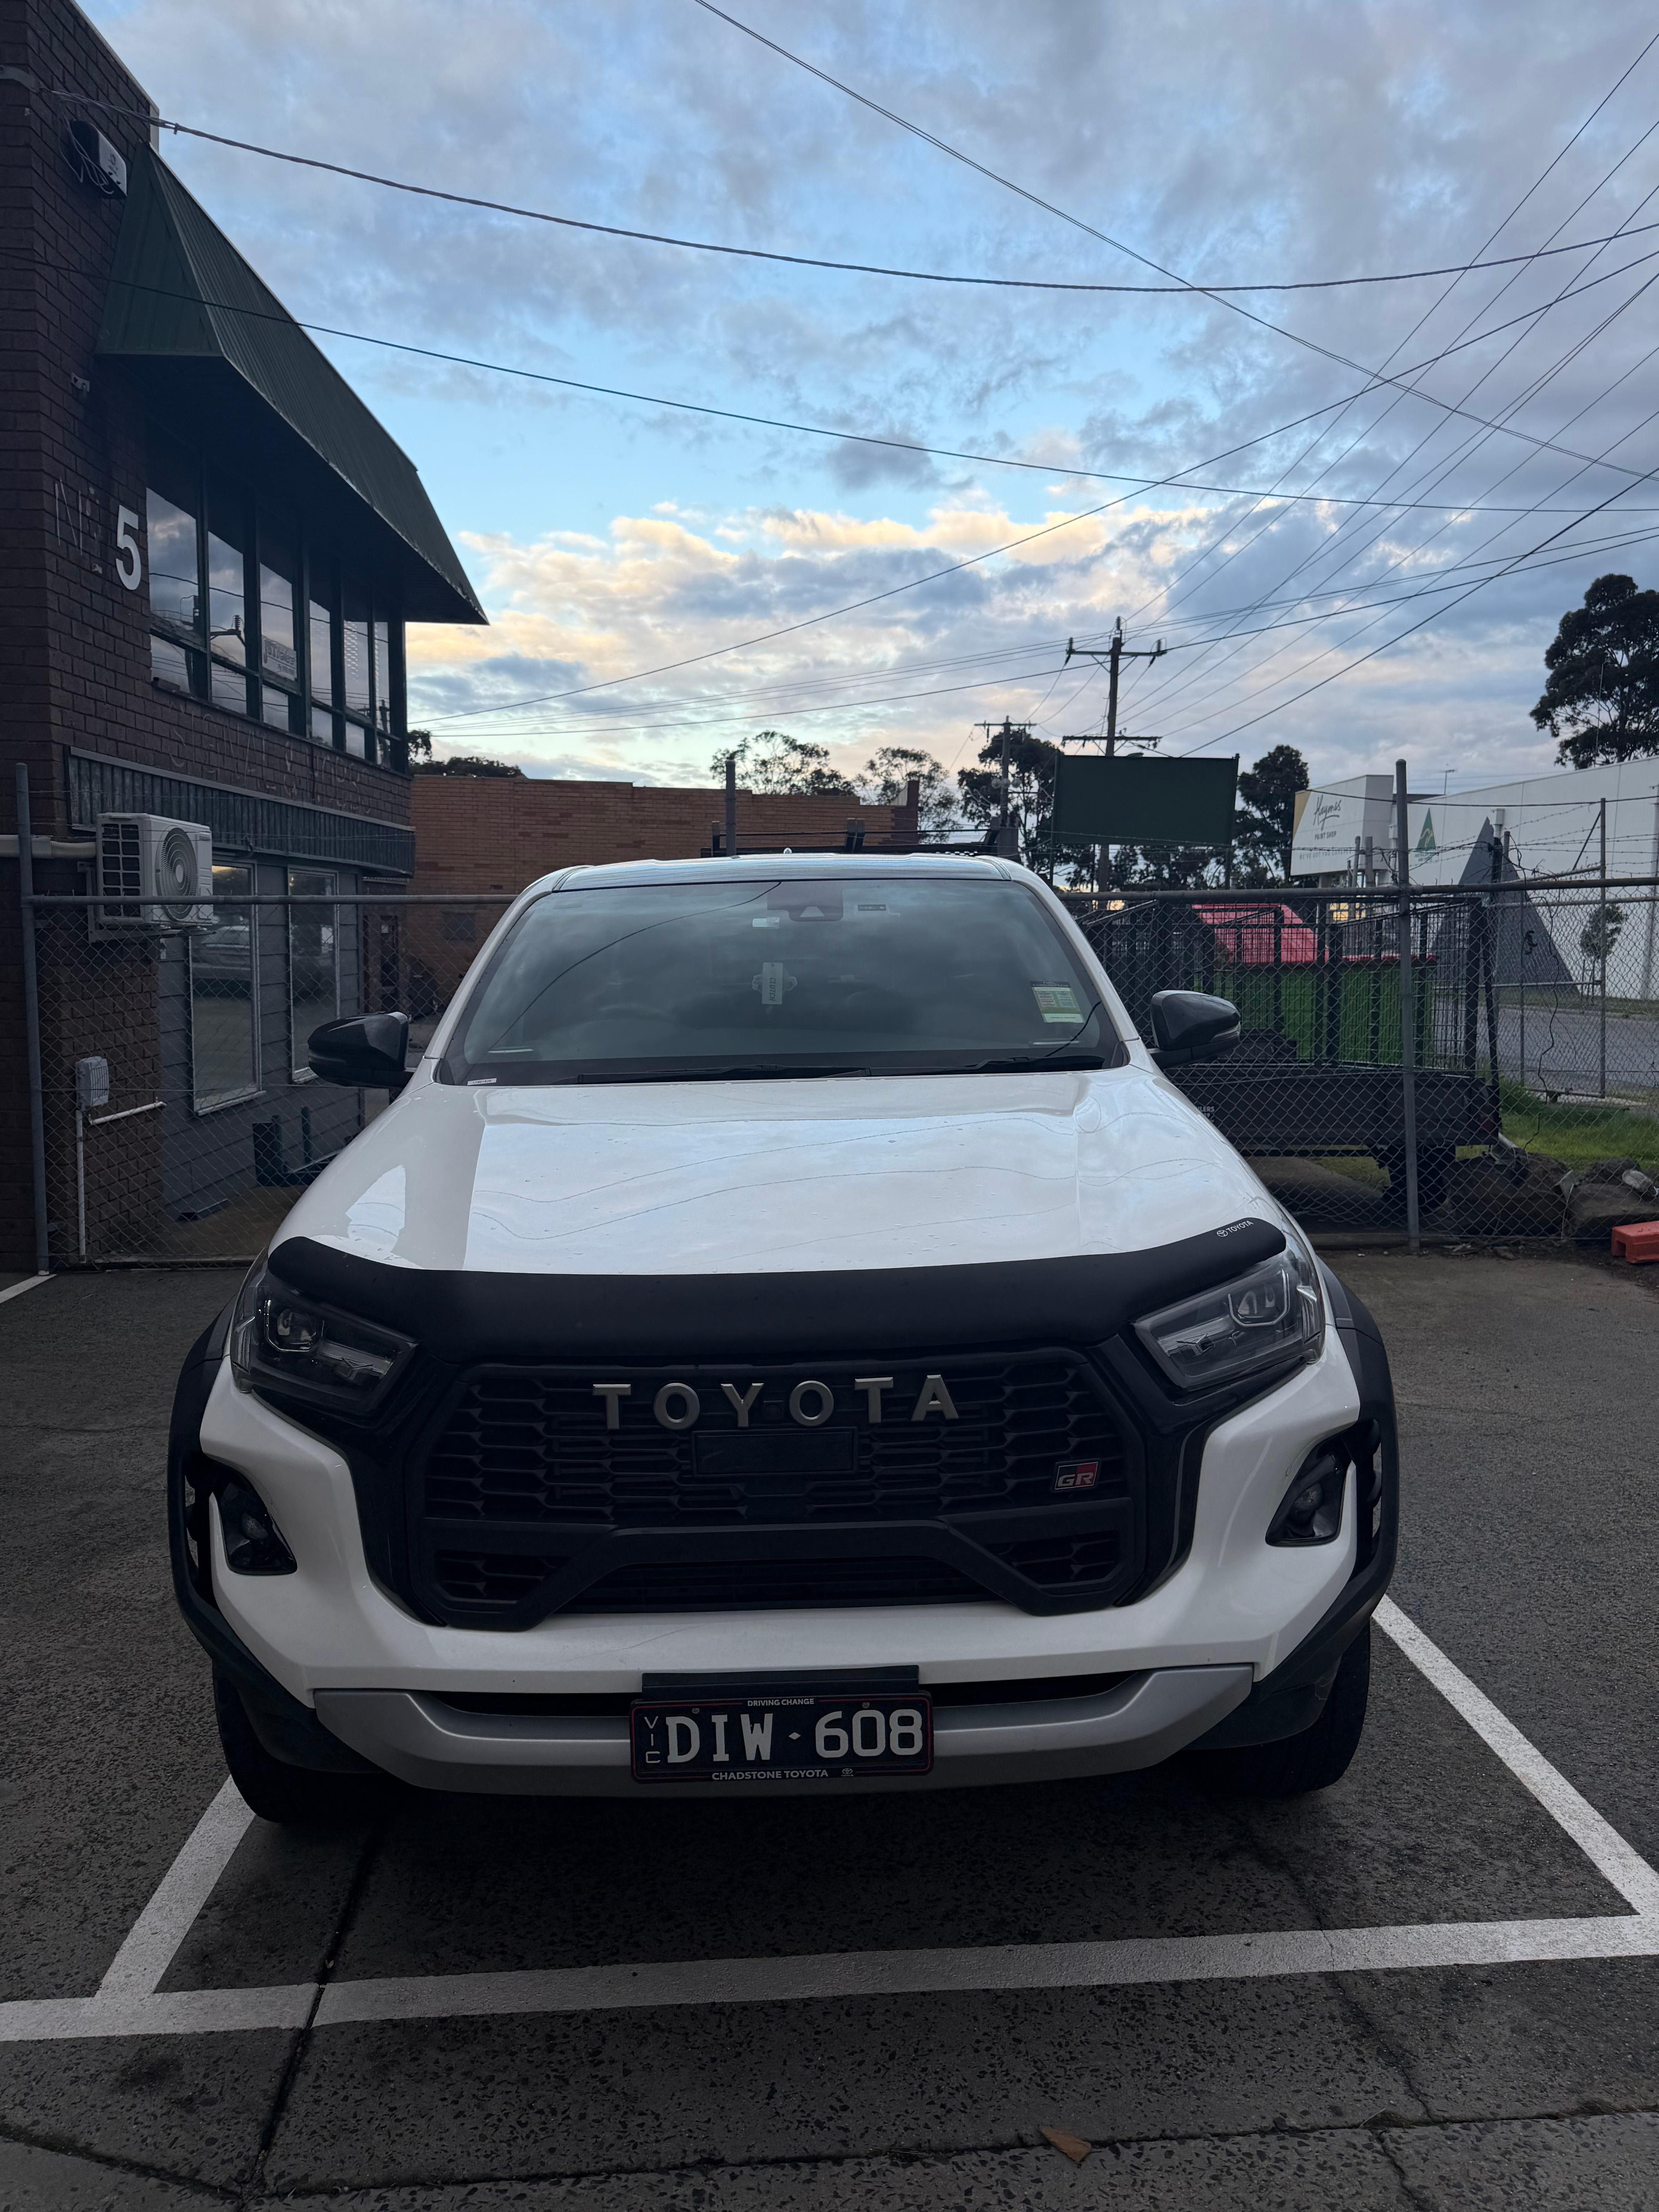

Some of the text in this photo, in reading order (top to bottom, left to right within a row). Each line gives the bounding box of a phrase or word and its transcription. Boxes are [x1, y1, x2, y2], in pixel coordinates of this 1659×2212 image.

[115, 505, 141, 591] 5
[1313, 794, 1342, 831] Haymes
[1314, 831, 1337, 840] PAINT SHOP
[1225, 1220, 1254, 1233] TOYOTA
[593, 1374, 959, 1430] TOYOTA
[1057, 1472, 1094, 1487] GR
[644, 1716, 661, 1764] VIC
[667, 1708, 923, 1764] DIW 608
[711, 1769, 829, 1781] CHADSTONE TOYOTA
